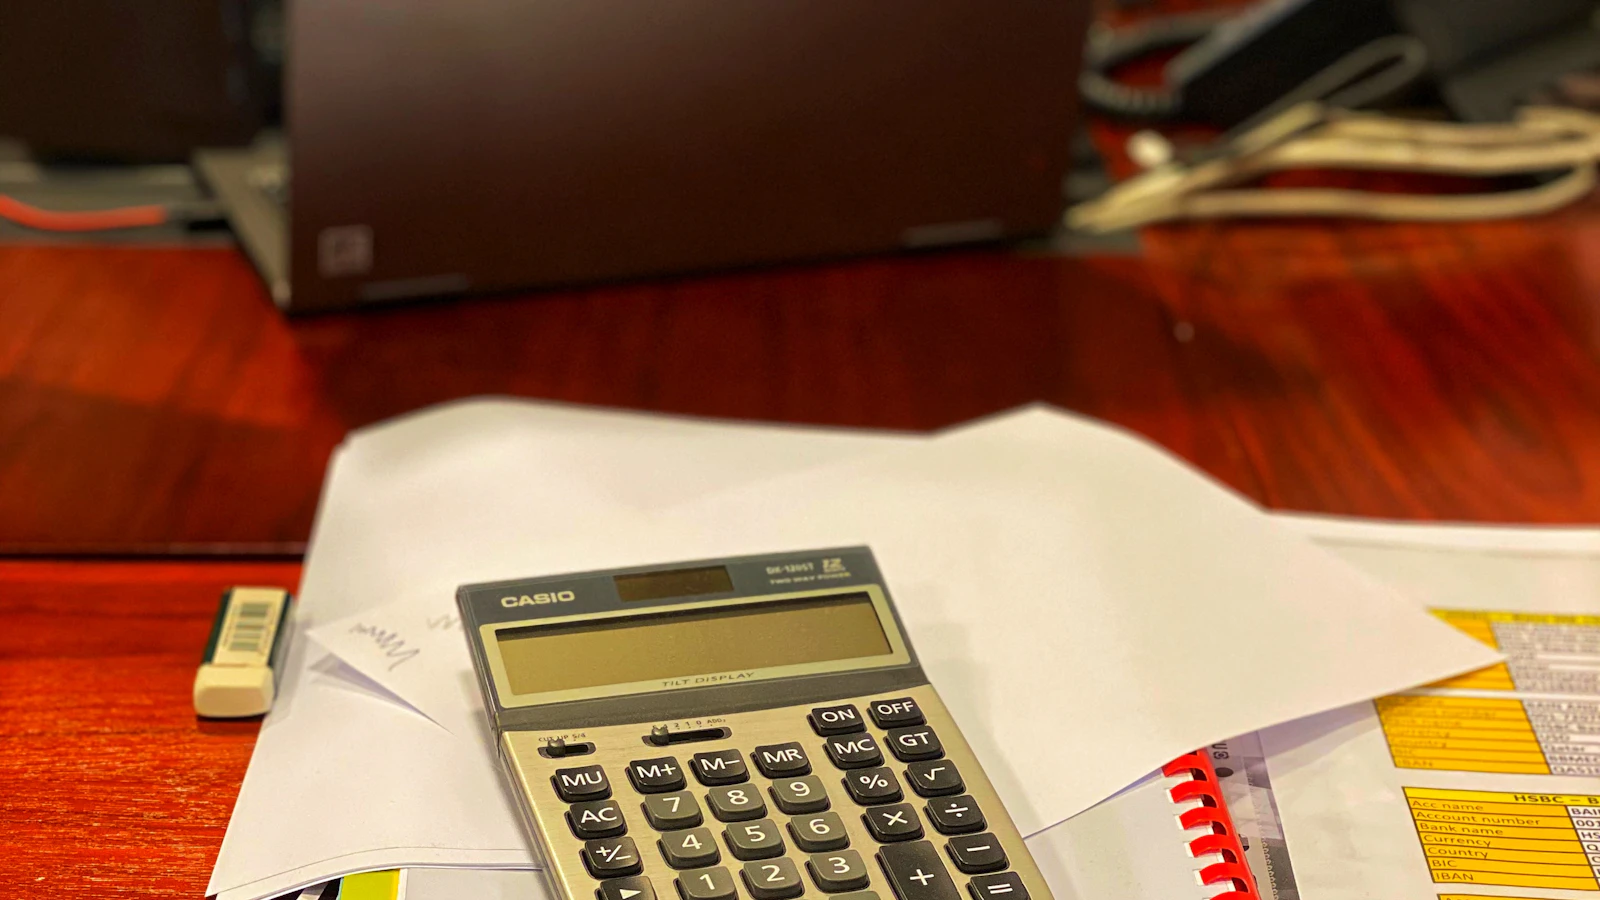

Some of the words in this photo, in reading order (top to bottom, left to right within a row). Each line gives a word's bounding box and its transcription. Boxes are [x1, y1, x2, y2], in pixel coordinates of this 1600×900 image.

[501, 590, 576, 608] CASIO
[662, 679, 690, 687] TILT
[695, 672, 754, 684] DISPLAY
[820, 708, 856, 723] ON
[877, 701, 914, 716] OFF
[833, 738, 875, 755] MC
[898, 731, 929, 747] GT
[763, 748, 803, 765] MR
[561, 770, 604, 787] MU
[636, 763, 677, 779] M+
[789, 781, 811, 797] 9
[859, 774, 889, 790] %
[662, 796, 681, 813] 7
[726, 789, 749, 806] 8
[1514, 794, 1564, 804] HSBC
[1412, 800, 1437, 808] Acc
[1442, 803, 1484, 812] name
[580, 807, 618, 824] AC
[1416, 811, 1478, 823] Account
[1482, 816, 1541, 826] number
[744, 825, 766, 843] 5
[808, 818, 830, 835] 6
[1419, 822, 1457, 833] Bank
[1461, 826, 1504, 836] name
[681, 834, 702, 851] 4
[1423, 834, 1492, 848] Currency
[1427, 846, 1488, 860] Country
[828, 856, 850, 874] 3
[1432, 859, 1458, 868] BIC
[761, 864, 785, 882] 2
[1435, 872, 1474, 881] IBAN
[699, 873, 716, 890] 1
